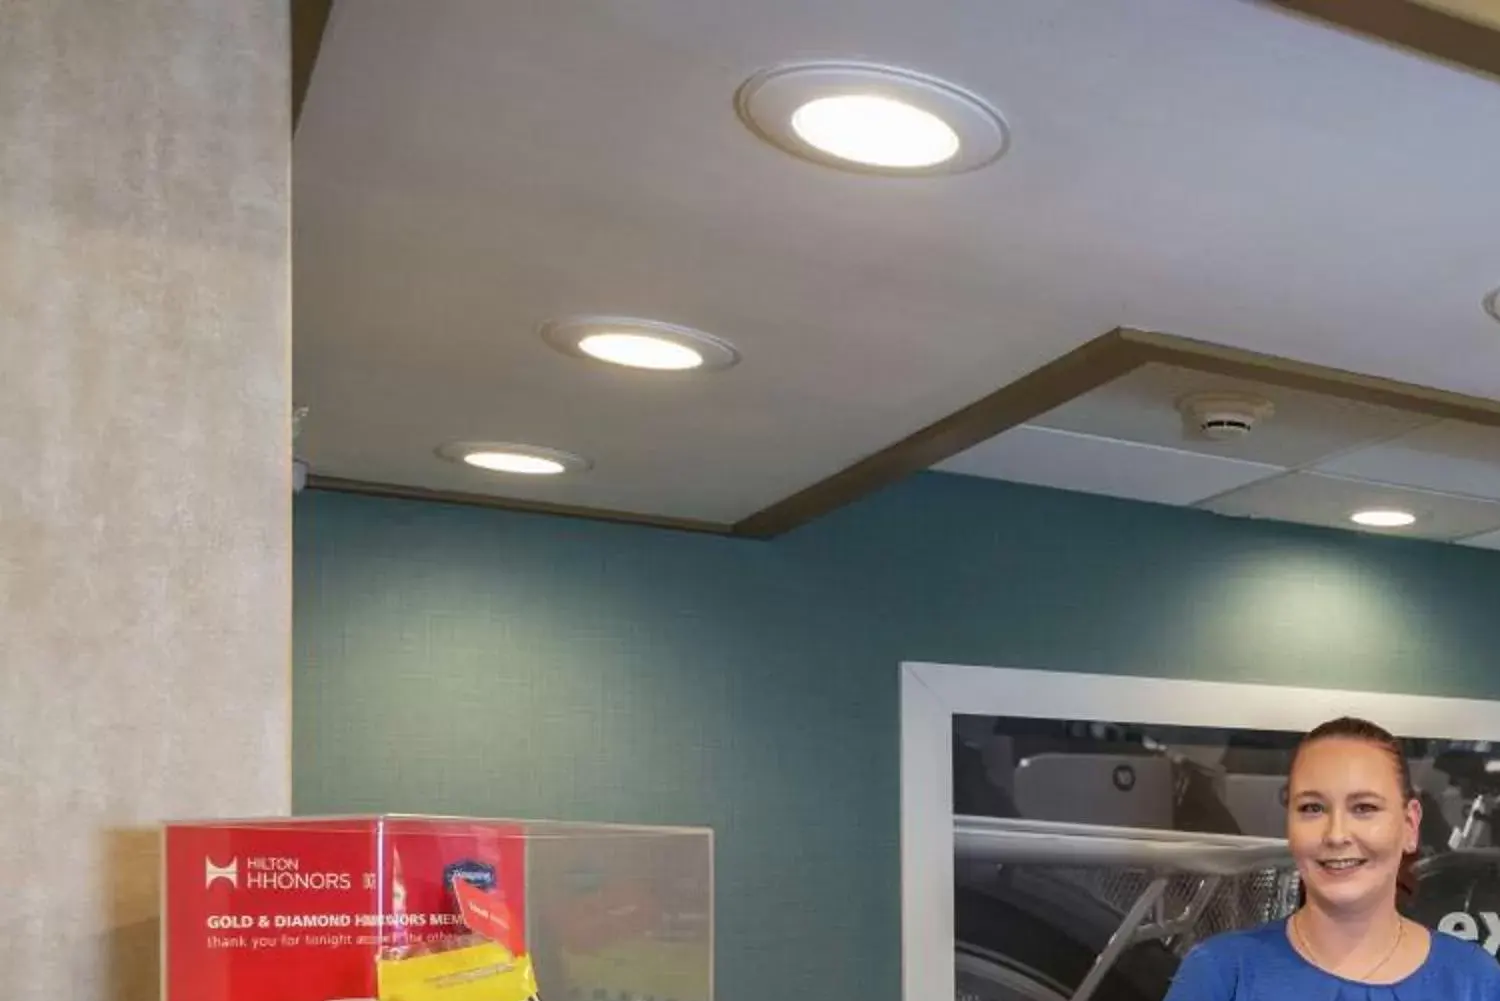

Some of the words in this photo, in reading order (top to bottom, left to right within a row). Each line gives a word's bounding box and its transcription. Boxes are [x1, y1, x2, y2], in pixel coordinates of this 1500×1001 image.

[247, 858, 299, 871] HILTON
[247, 873, 351, 889] HHONORS
[207, 915, 253, 929] GOLD
[258, 915, 269, 928] &
[274, 913, 350, 928] DIAMOND
[207, 935, 247, 949] thank
[252, 937, 277, 949] you
[281, 933, 300, 946] for
[305, 933, 353, 948] tonight
